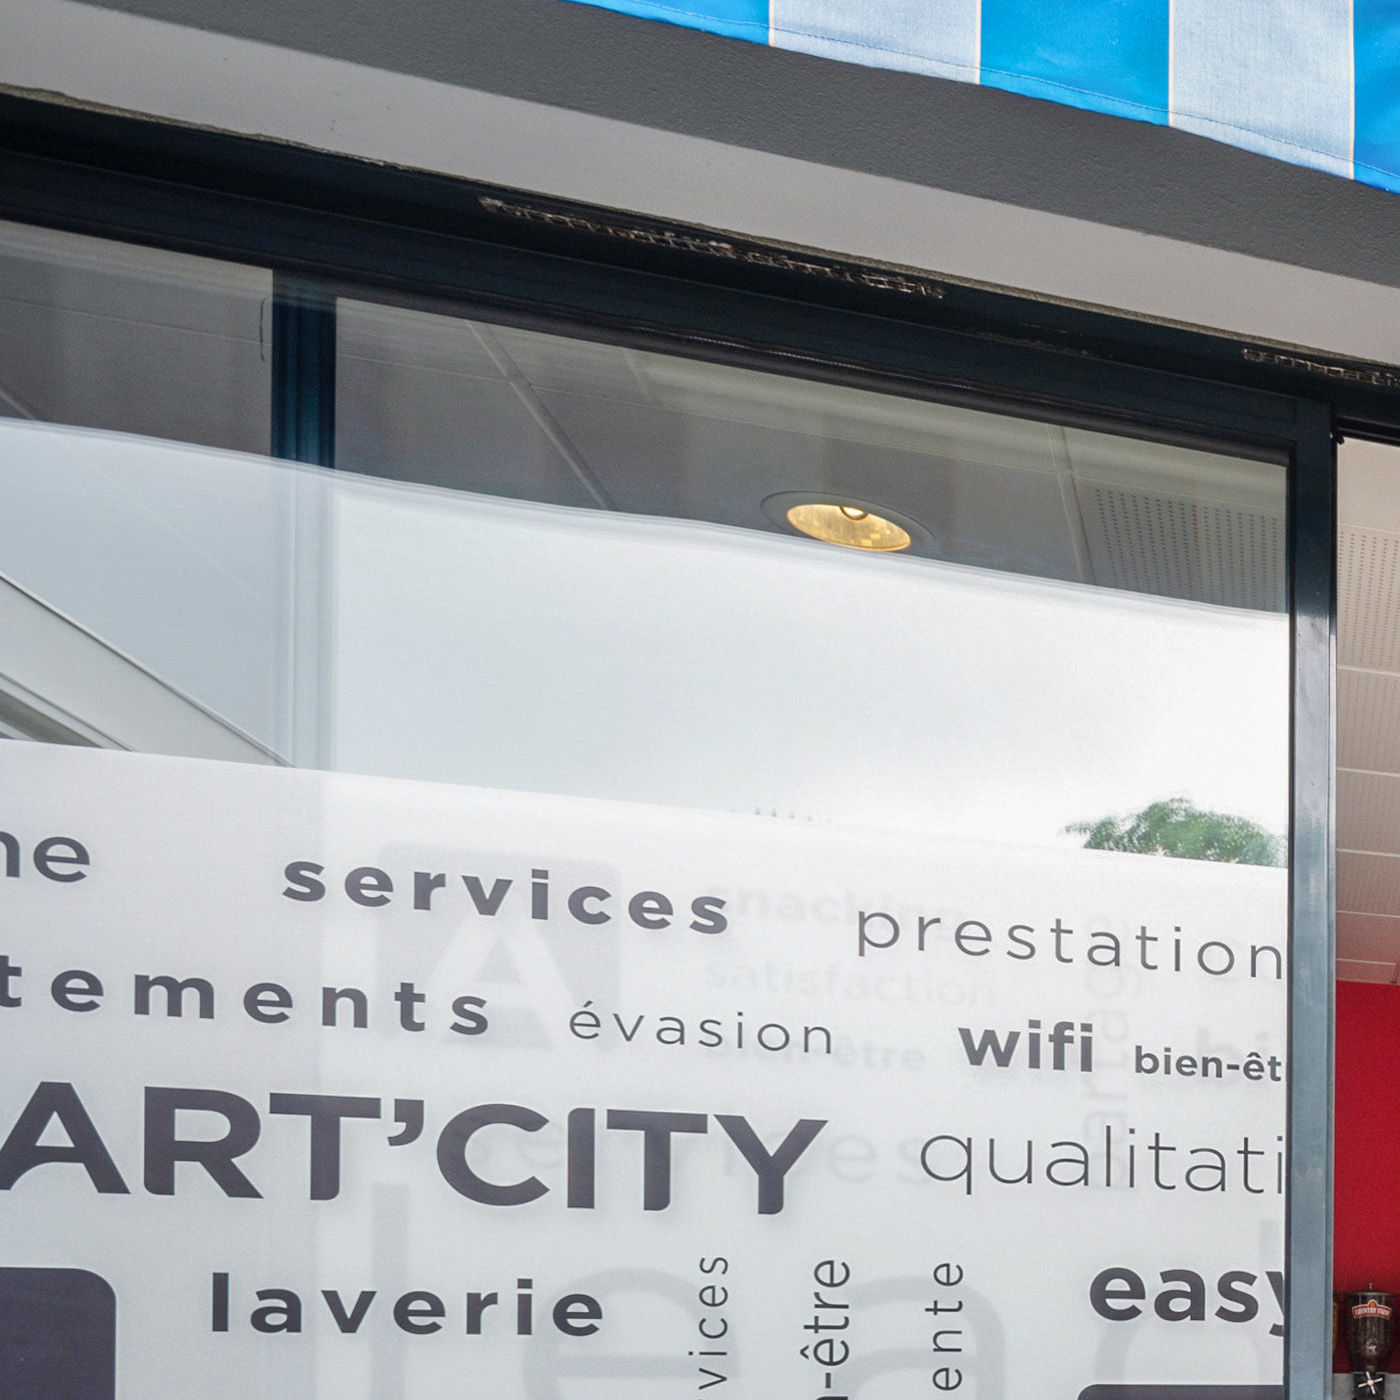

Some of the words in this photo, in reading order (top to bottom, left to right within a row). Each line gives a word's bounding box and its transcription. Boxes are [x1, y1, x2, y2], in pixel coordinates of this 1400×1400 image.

[282, 858, 731, 932] services
[857, 909, 1286, 980] prestation
[570, 1000, 831, 1054] évasion
[958, 1020, 1092, 1072] wifi
[1134, 1046, 1284, 1083] bien-êt
[0, 1081, 828, 1215] ART'CITY
[921, 1126, 1282, 1195] qualitati
[212, 1272, 602, 1336] laverie
